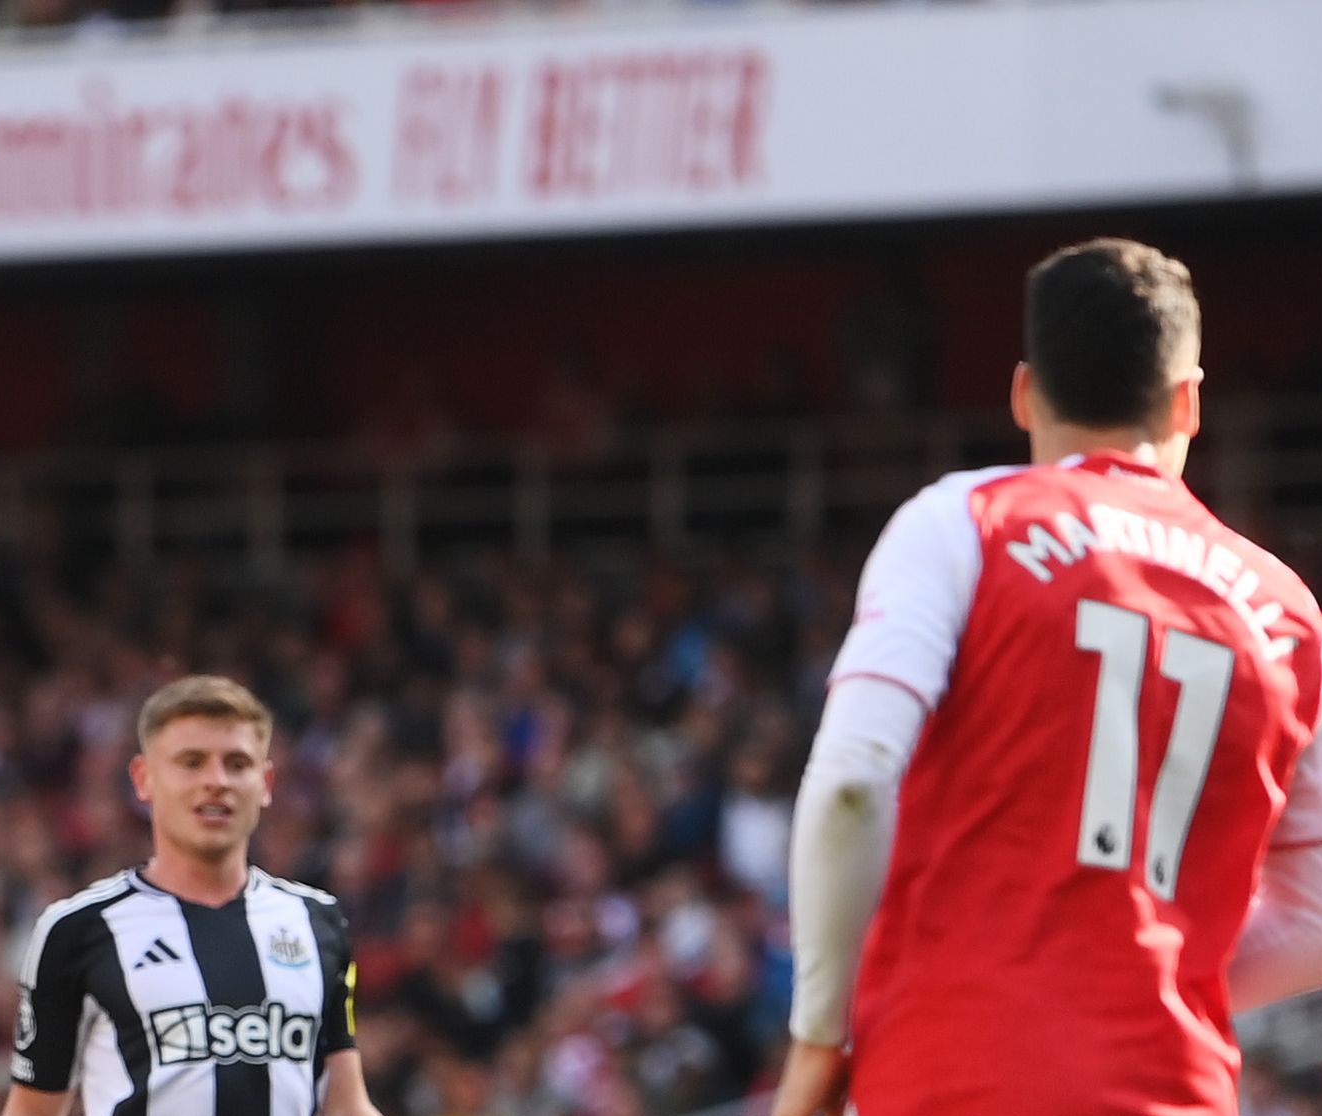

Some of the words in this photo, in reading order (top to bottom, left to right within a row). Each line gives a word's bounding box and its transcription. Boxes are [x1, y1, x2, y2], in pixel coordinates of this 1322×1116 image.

[391, 64, 513, 204] FLY
[523, 50, 773, 200] BETTER
[1075, 598, 1235, 902] 11
[207, 1002, 317, 1062] sela
